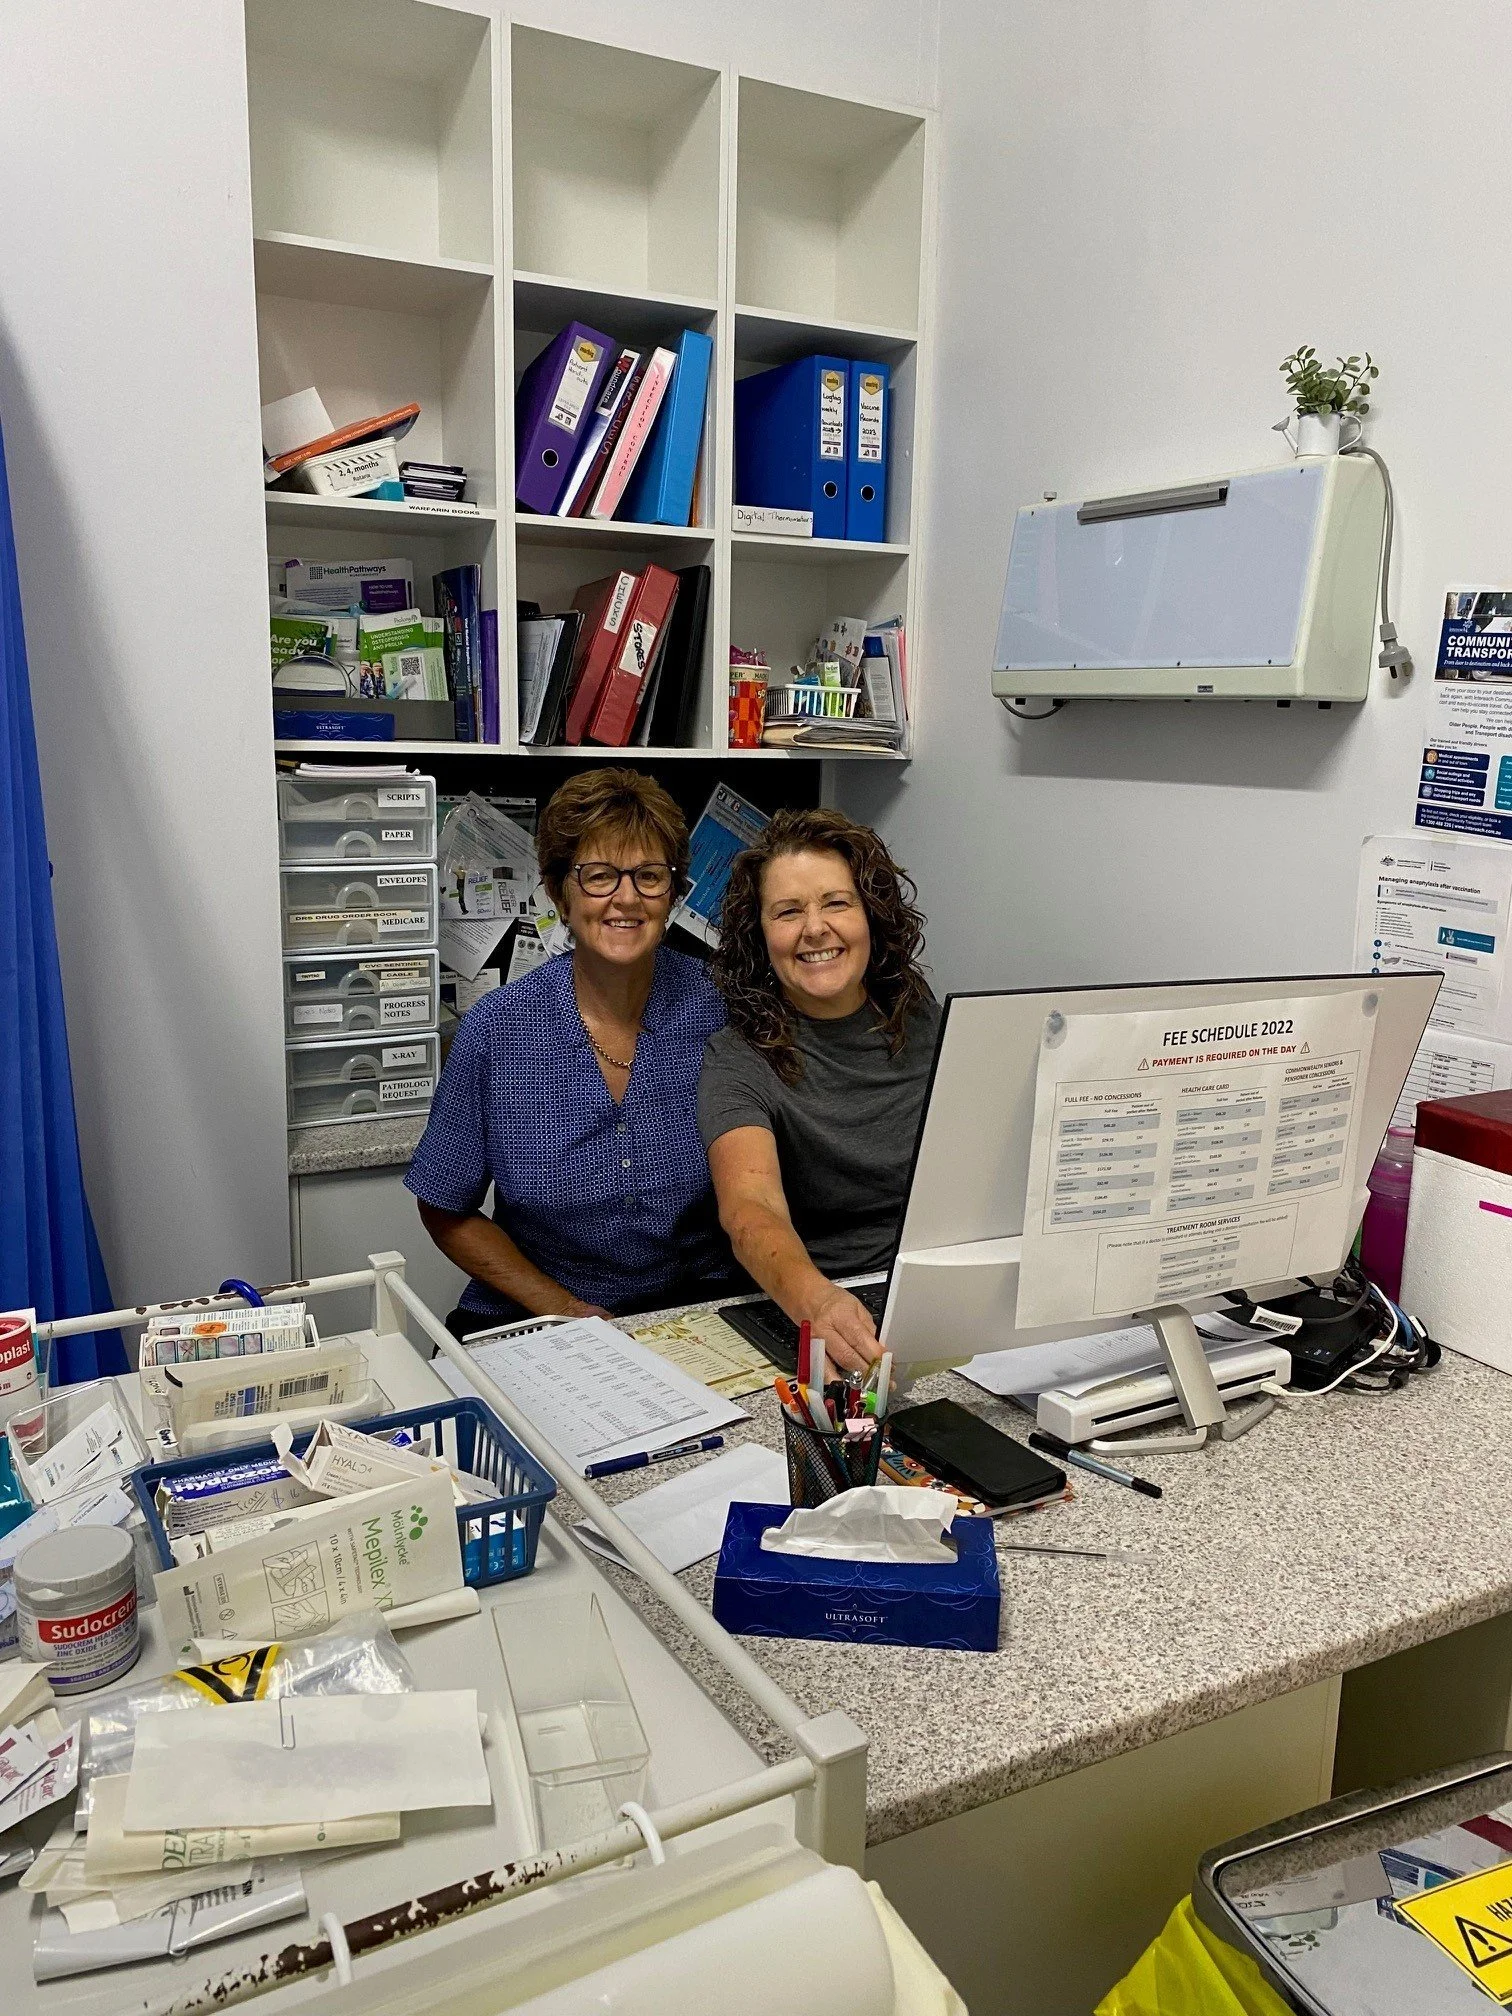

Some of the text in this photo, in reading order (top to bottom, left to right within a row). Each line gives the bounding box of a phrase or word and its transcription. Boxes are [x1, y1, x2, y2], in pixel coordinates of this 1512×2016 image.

[354, 460, 379, 473] months
[408, 504, 481, 516] WARFARIN BOOKS
[737, 509, 765, 526] Digital
[323, 564, 387, 575] HealthPathways
[270, 634, 318, 651] Are you
[633, 622, 646, 670] STORES
[386, 793, 421, 801] SCRIPTS
[384, 831, 411, 839] PAPER
[379, 876, 427, 885] ENVELOPES
[1378, 876, 1408, 884] Managing
[1409, 877, 1439, 888] anaphylaxis
[1452, 885, 1481, 894] vaccination
[381, 916, 426, 926] MEDICARE
[384, 1000, 426, 1010] PROGRESS
[384, 1010, 411, 1019] NOTES
[1163, 1019, 1294, 1046] FEE SCHEDULE 2022
[392, 1051, 417, 1060] X-RAY
[1151, 1045, 1297, 1067] PAYMENT IS REQUIRED ON THE DAY
[1285, 1062, 1323, 1075] COMMONWEALTH
[1284, 1069, 1336, 1082] PENSIONER CONCESSIONS
[382, 1080, 431, 1091] PATHOLOGY
[382, 1090, 419, 1099] REQUEST
[1104, 1092, 1142, 1100] CONCESSIONS
[1167, 1215, 1241, 1234] TREATMENT ROOM SERVICES
[172, 1469, 226, 1484] PHARMACIST
[228, 1464, 248, 1473] ONLY
[329, 1533, 339, 1546] 10
[333, 1553, 343, 1576] 10cm
[51, 1595, 137, 1641] Sudocrem
[825, 1612, 884, 1624] ULTRASOFT
[53, 1624, 122, 1651] SUDOCREM HEALING
[56, 1649, 74, 1657] ZINC
[75, 1644, 97, 1655] OXIDE
